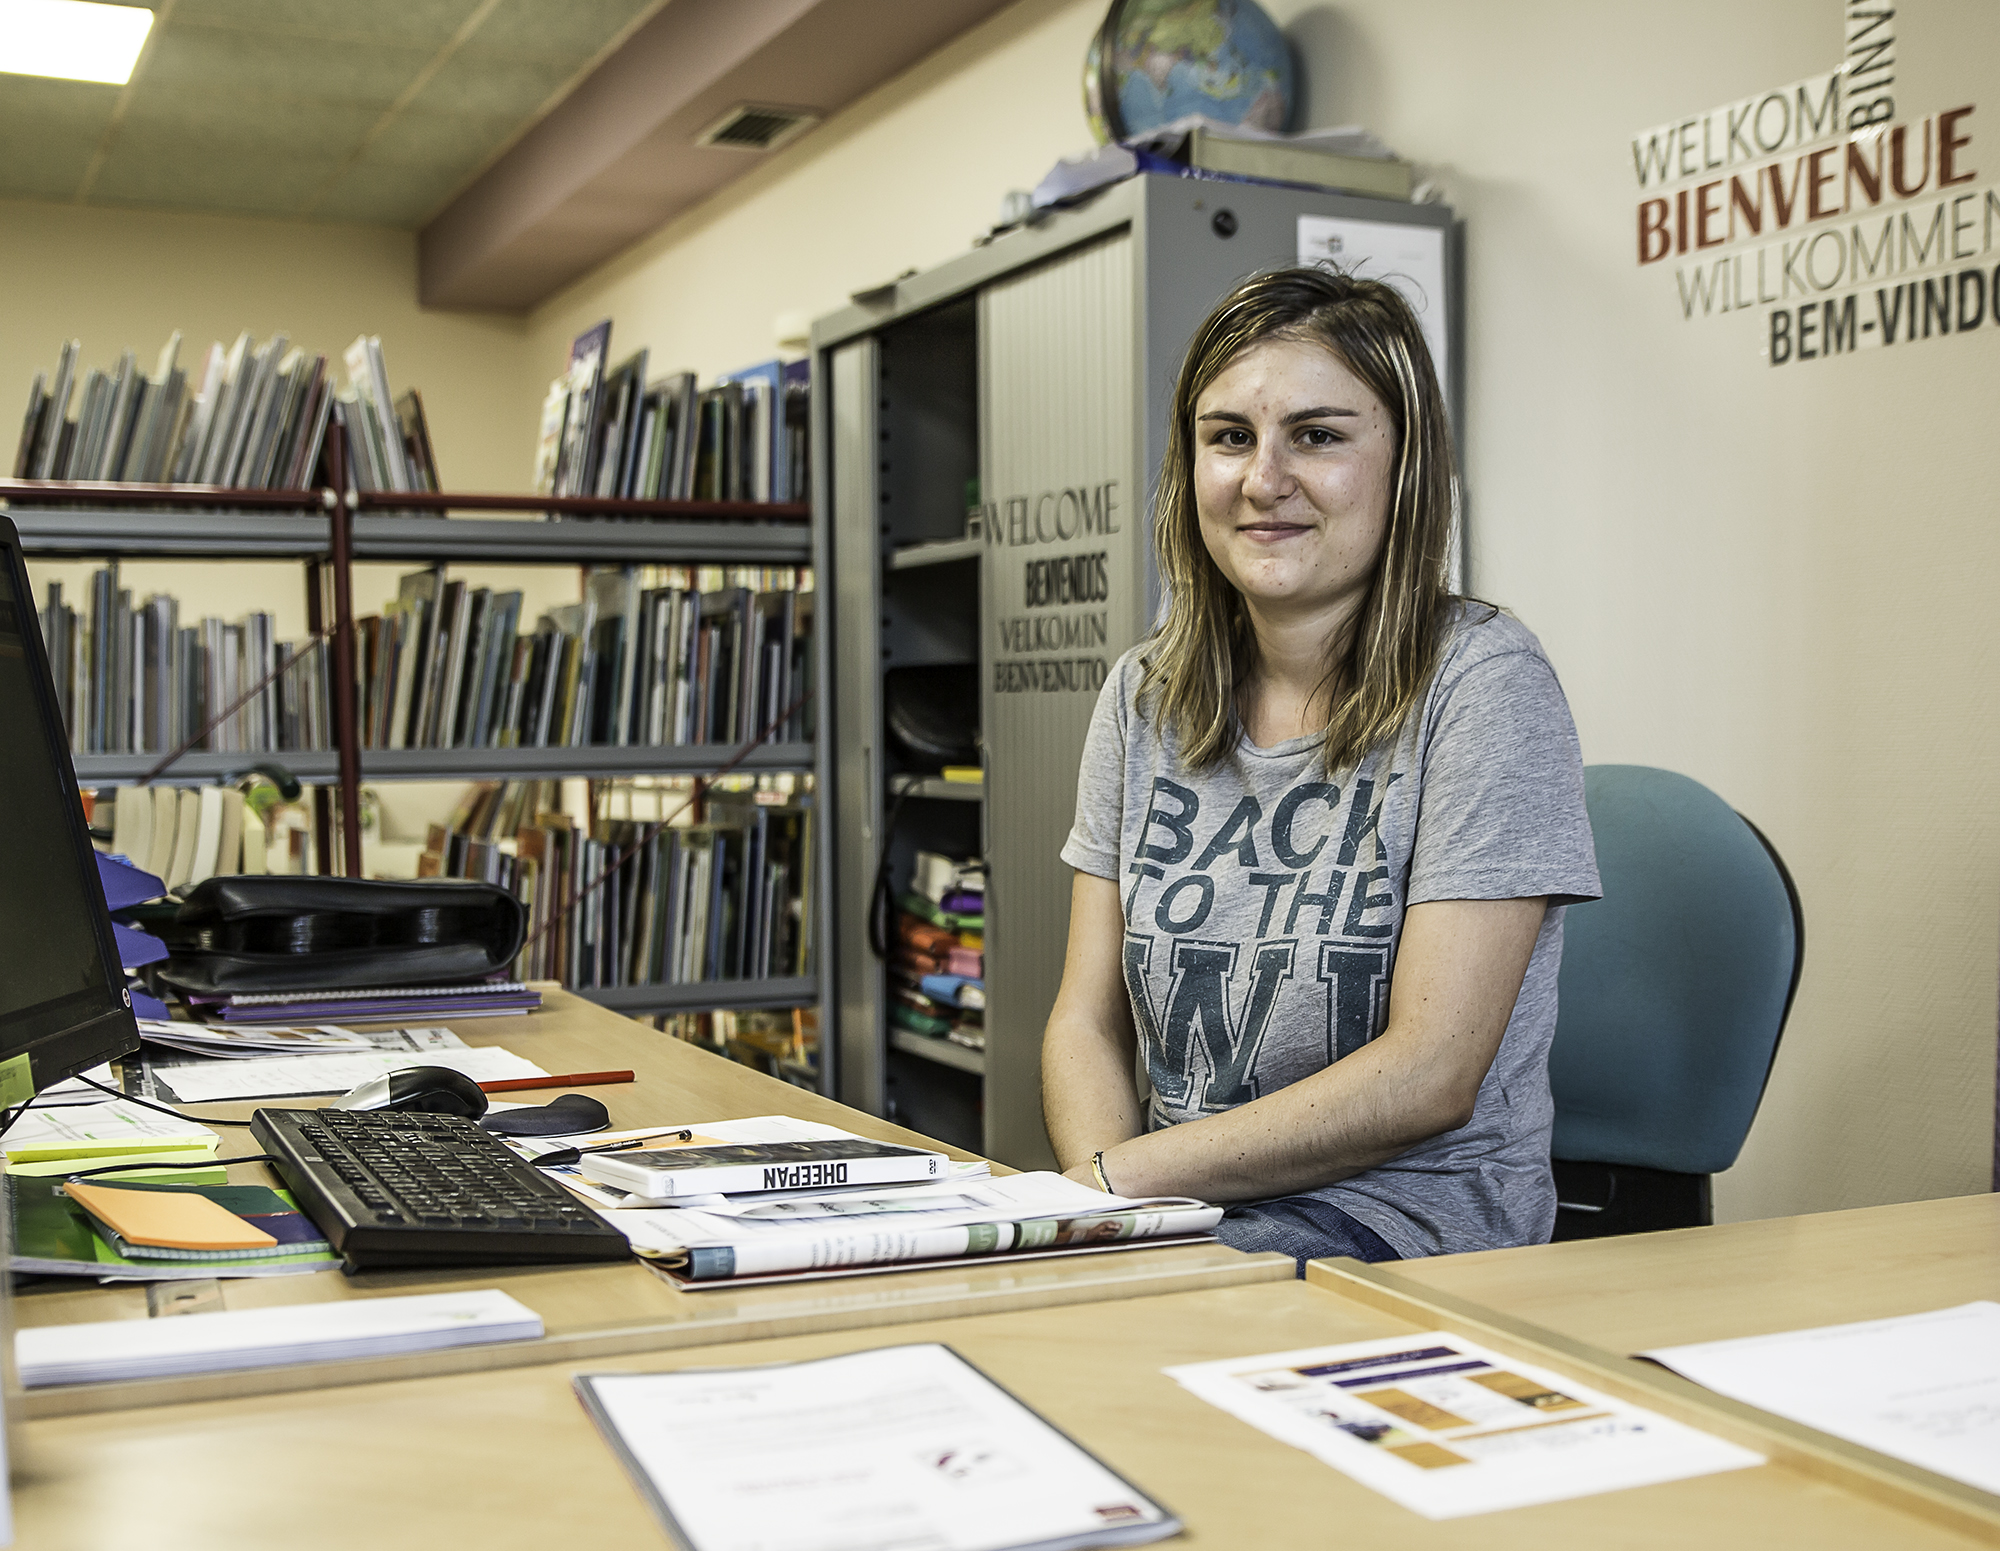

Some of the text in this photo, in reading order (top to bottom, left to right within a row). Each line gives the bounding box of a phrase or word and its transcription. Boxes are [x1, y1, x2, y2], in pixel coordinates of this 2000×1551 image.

[1847, 0, 1896, 131] BINV
[1631, 72, 1840, 189] WELKOM
[1636, 103, 1978, 267] BIENVENUE
[982, 478, 1121, 547] WELCOME
[1134, 773, 1404, 871] BACK
[1126, 862, 1394, 939] TO THE
[763, 1162, 848, 1189] DHEEPAN
